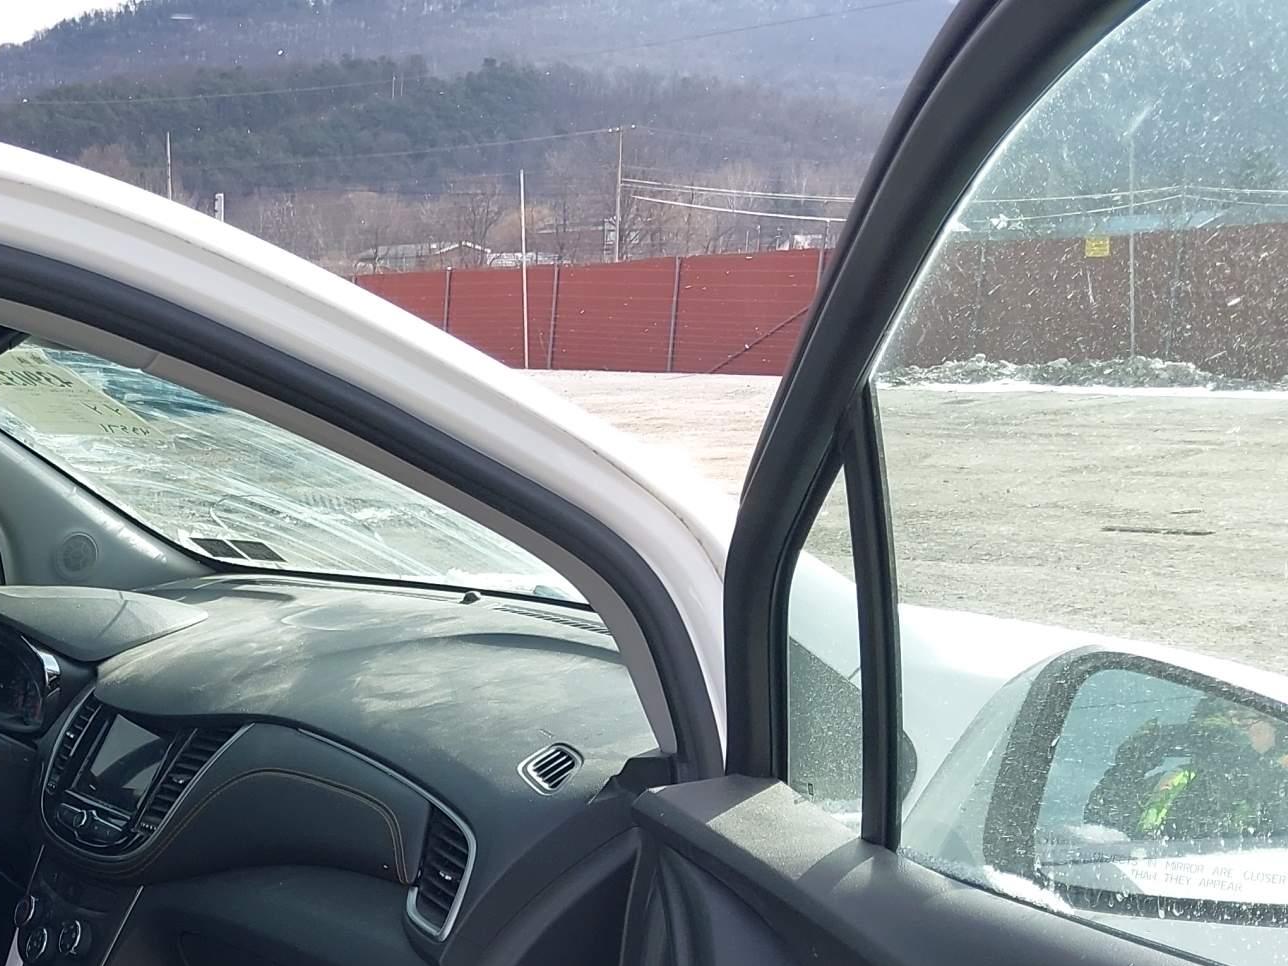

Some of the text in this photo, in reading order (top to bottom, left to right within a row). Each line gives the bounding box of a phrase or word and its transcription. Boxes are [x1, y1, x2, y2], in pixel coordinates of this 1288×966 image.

[1130, 868, 1244, 893] THAN THEY APPEAR
[1164, 860, 1205, 874] MIRROR
[1211, 865, 1234, 878] ARE
[1242, 869, 1287, 885] CLOSER
